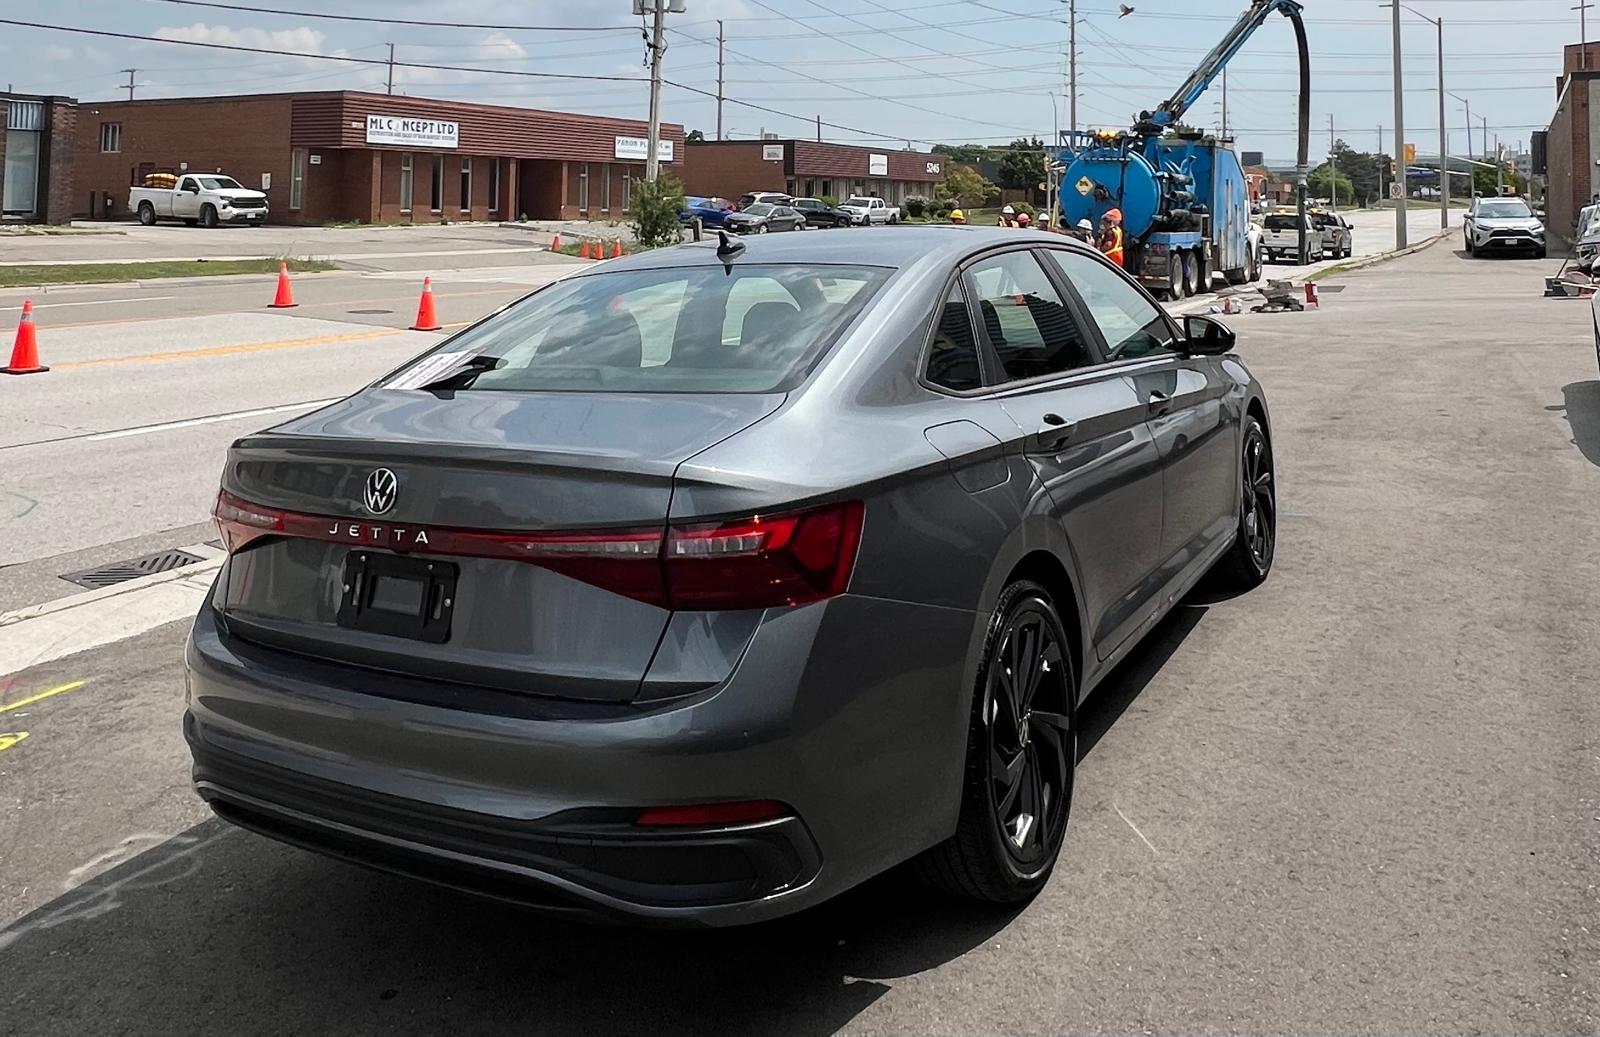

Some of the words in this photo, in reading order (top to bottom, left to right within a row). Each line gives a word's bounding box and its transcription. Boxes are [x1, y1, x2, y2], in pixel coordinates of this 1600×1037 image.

[370, 118, 384, 129] ML
[387, 119, 434, 133] CNCEPT
[328, 522, 429, 545] JETTA
